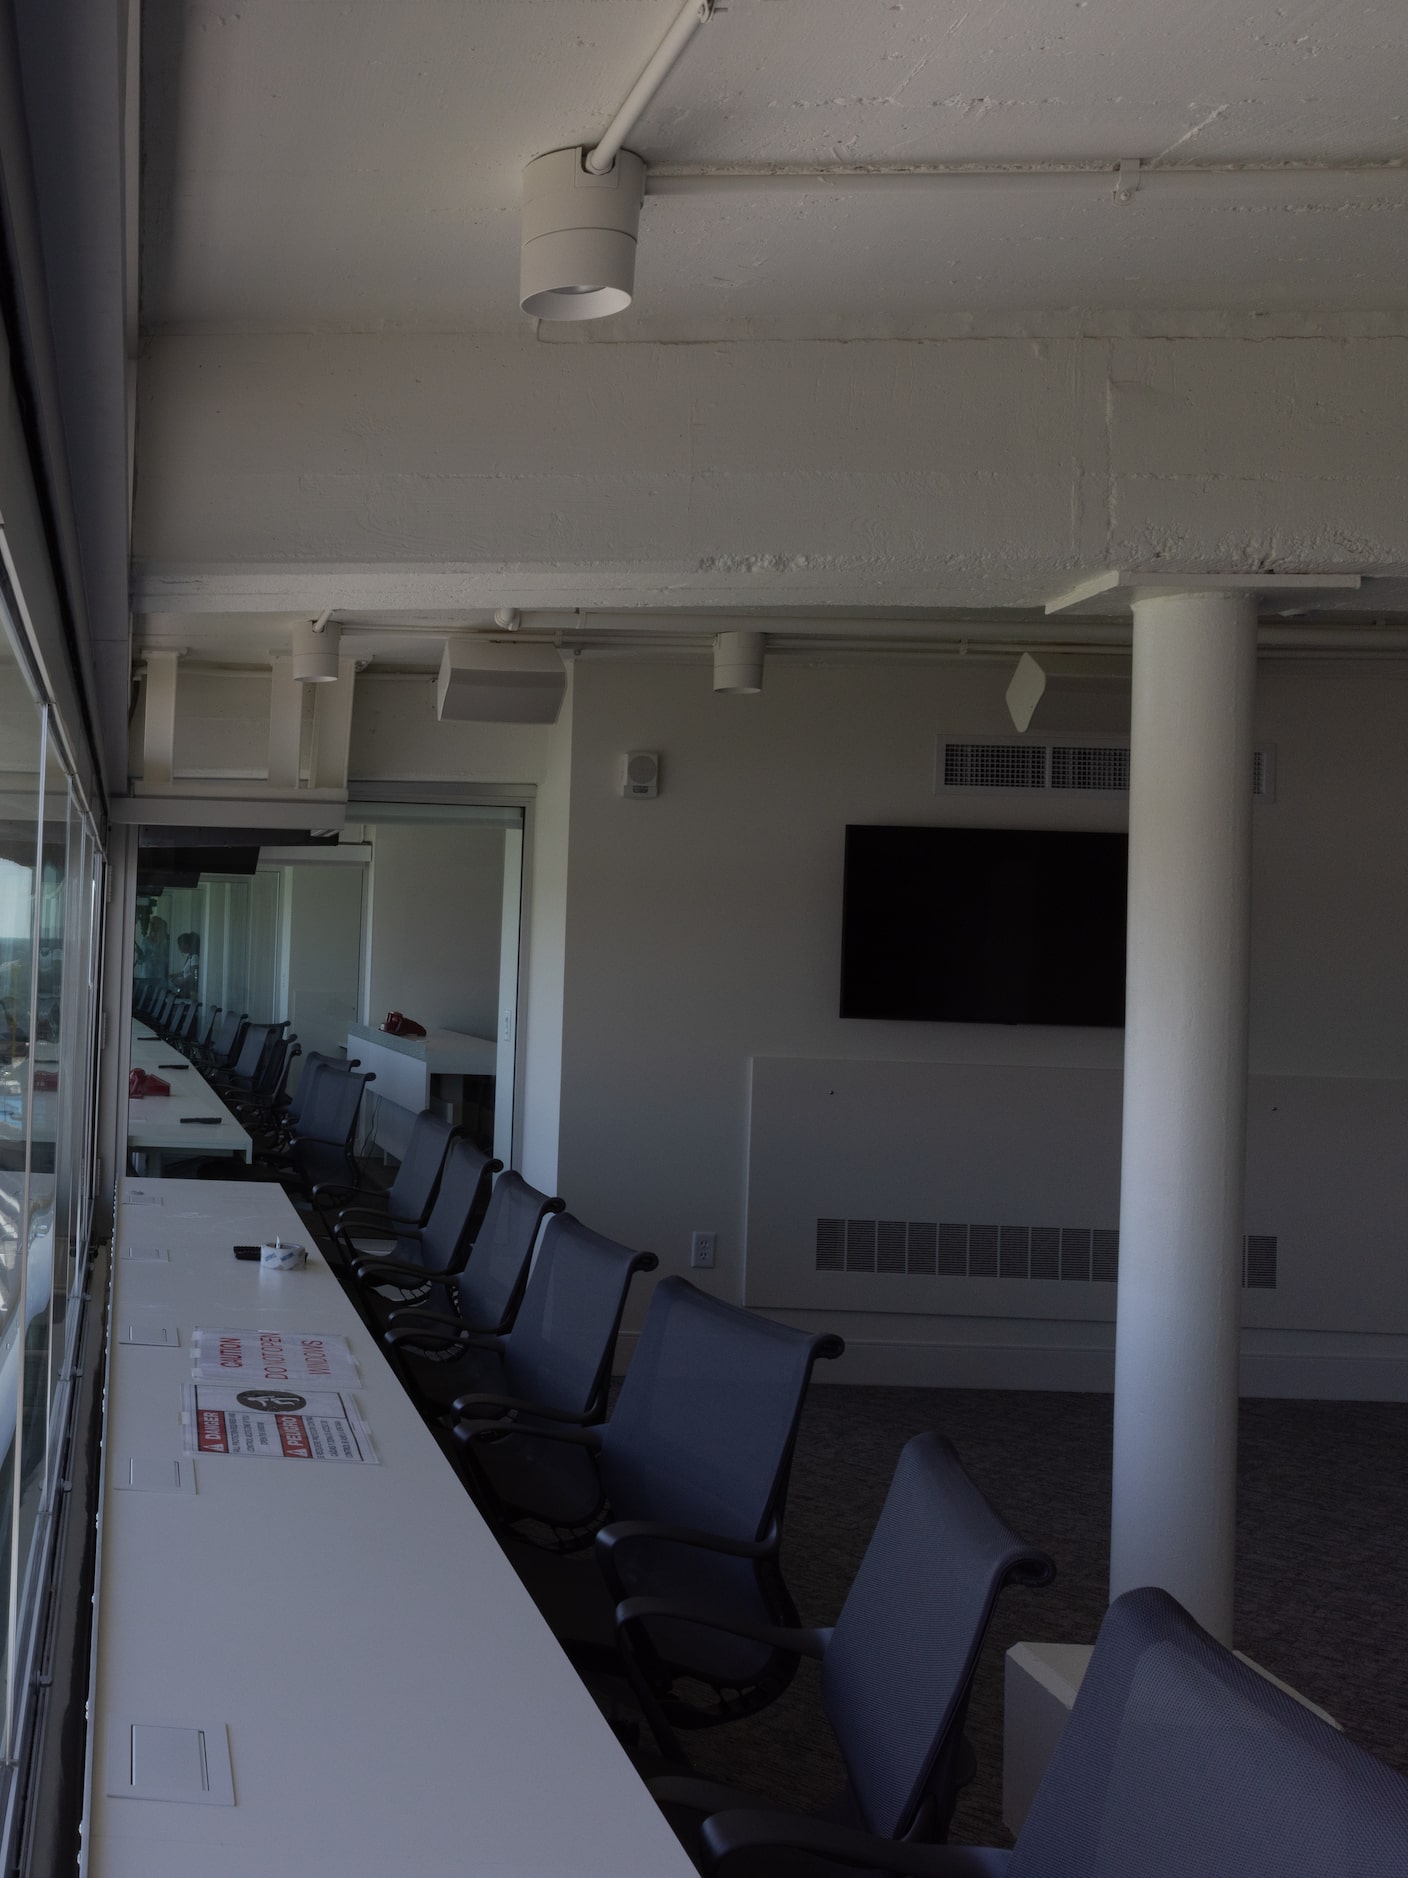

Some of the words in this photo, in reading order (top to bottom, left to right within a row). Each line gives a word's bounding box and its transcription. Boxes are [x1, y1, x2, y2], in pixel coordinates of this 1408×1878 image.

[219, 1337, 243, 1368] CAUTION
[259, 1332, 283, 1352] OPEN
[261, 1352, 287, 1366] NOT
[301, 1340, 333, 1375] WINDOWS
[263, 1366, 289, 1380] DO
[203, 1411, 221, 1440] DANGER
[281, 1416, 304, 1447] PELIGRO
